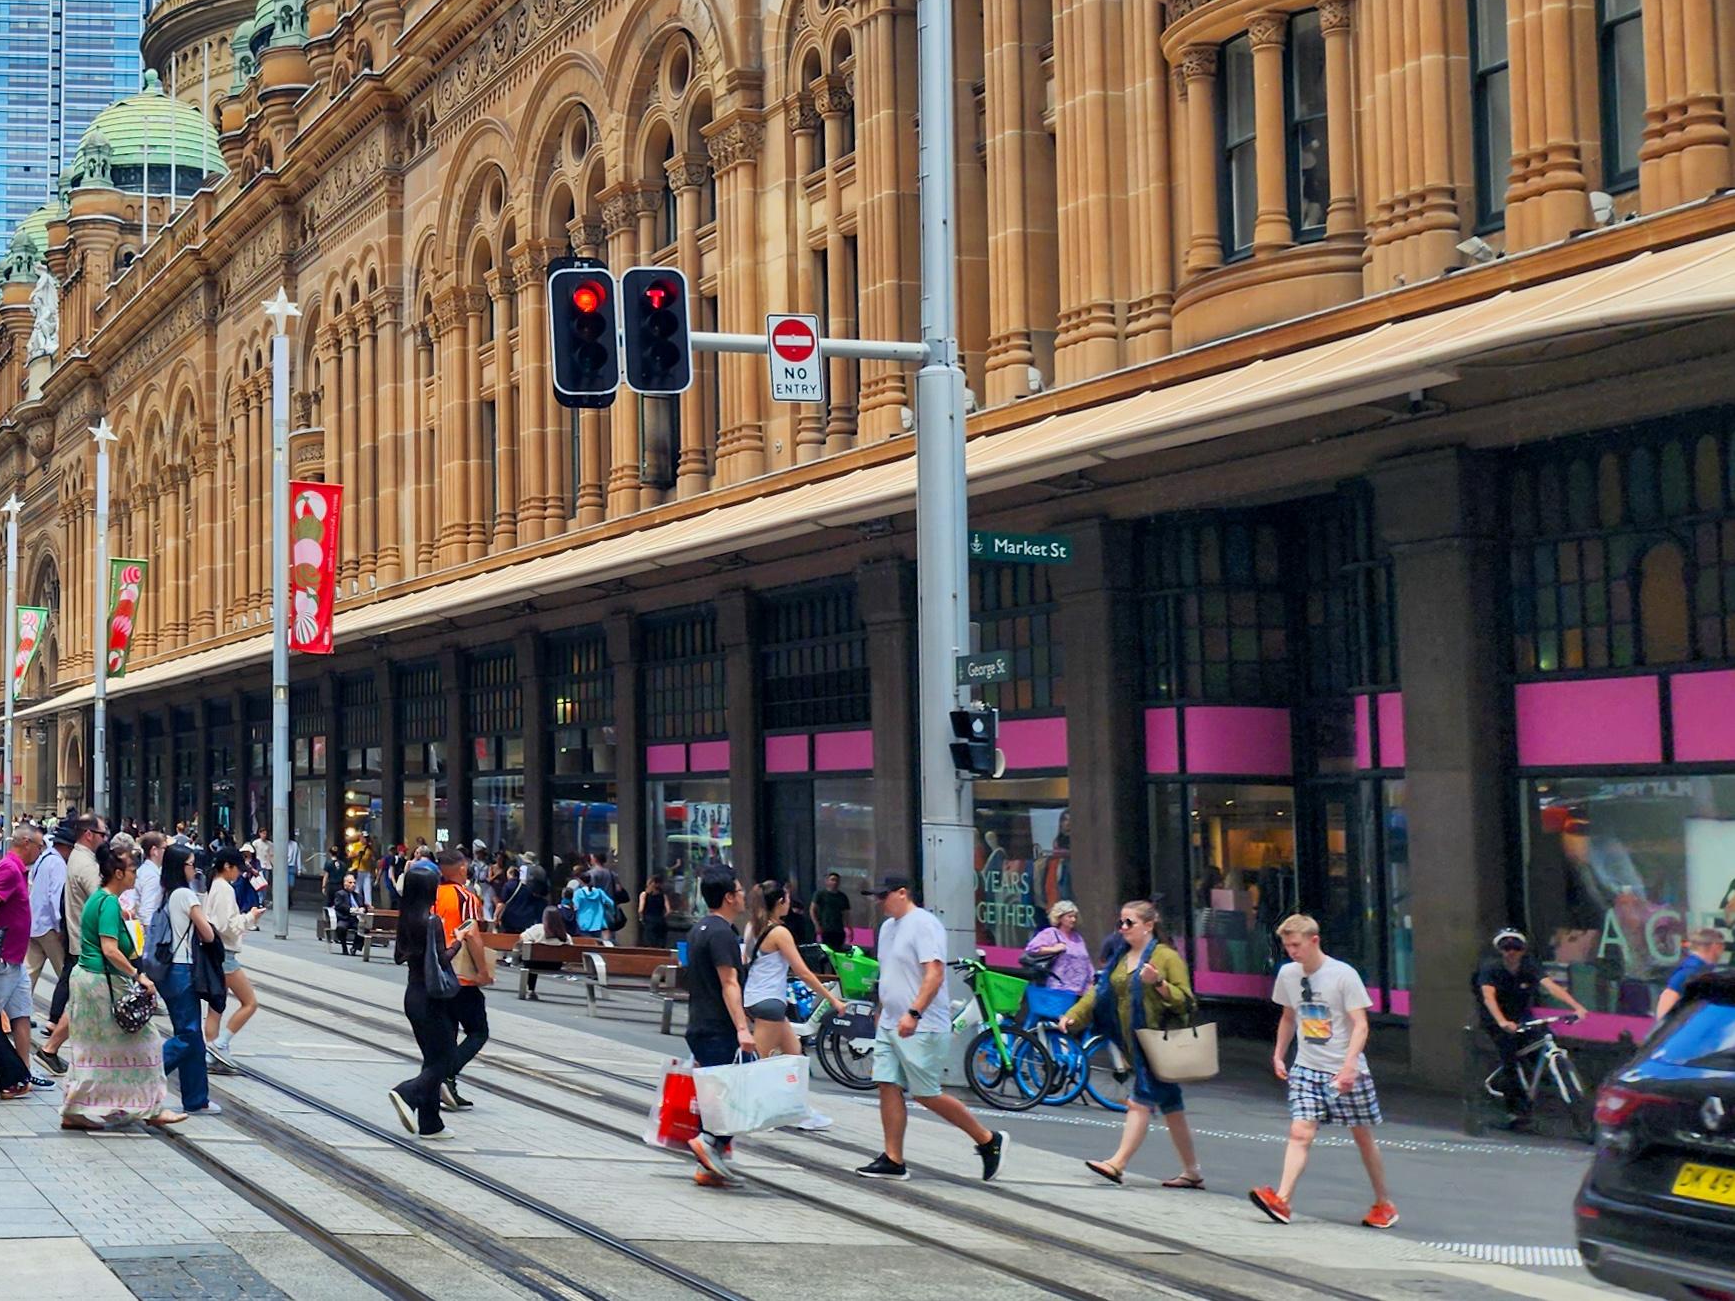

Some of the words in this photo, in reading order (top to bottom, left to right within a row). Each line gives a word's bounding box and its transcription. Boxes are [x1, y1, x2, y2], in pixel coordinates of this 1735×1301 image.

[784, 367, 807, 379] NO
[776, 383, 817, 394] ENTRY
[994, 538, 1048, 557] Market
[1050, 542, 1067, 558] St
[967, 661, 996, 680] George
[997, 658, 1006, 674] St
[982, 870, 1030, 894] YEARS
[976, 901, 1037, 928] GETHER
